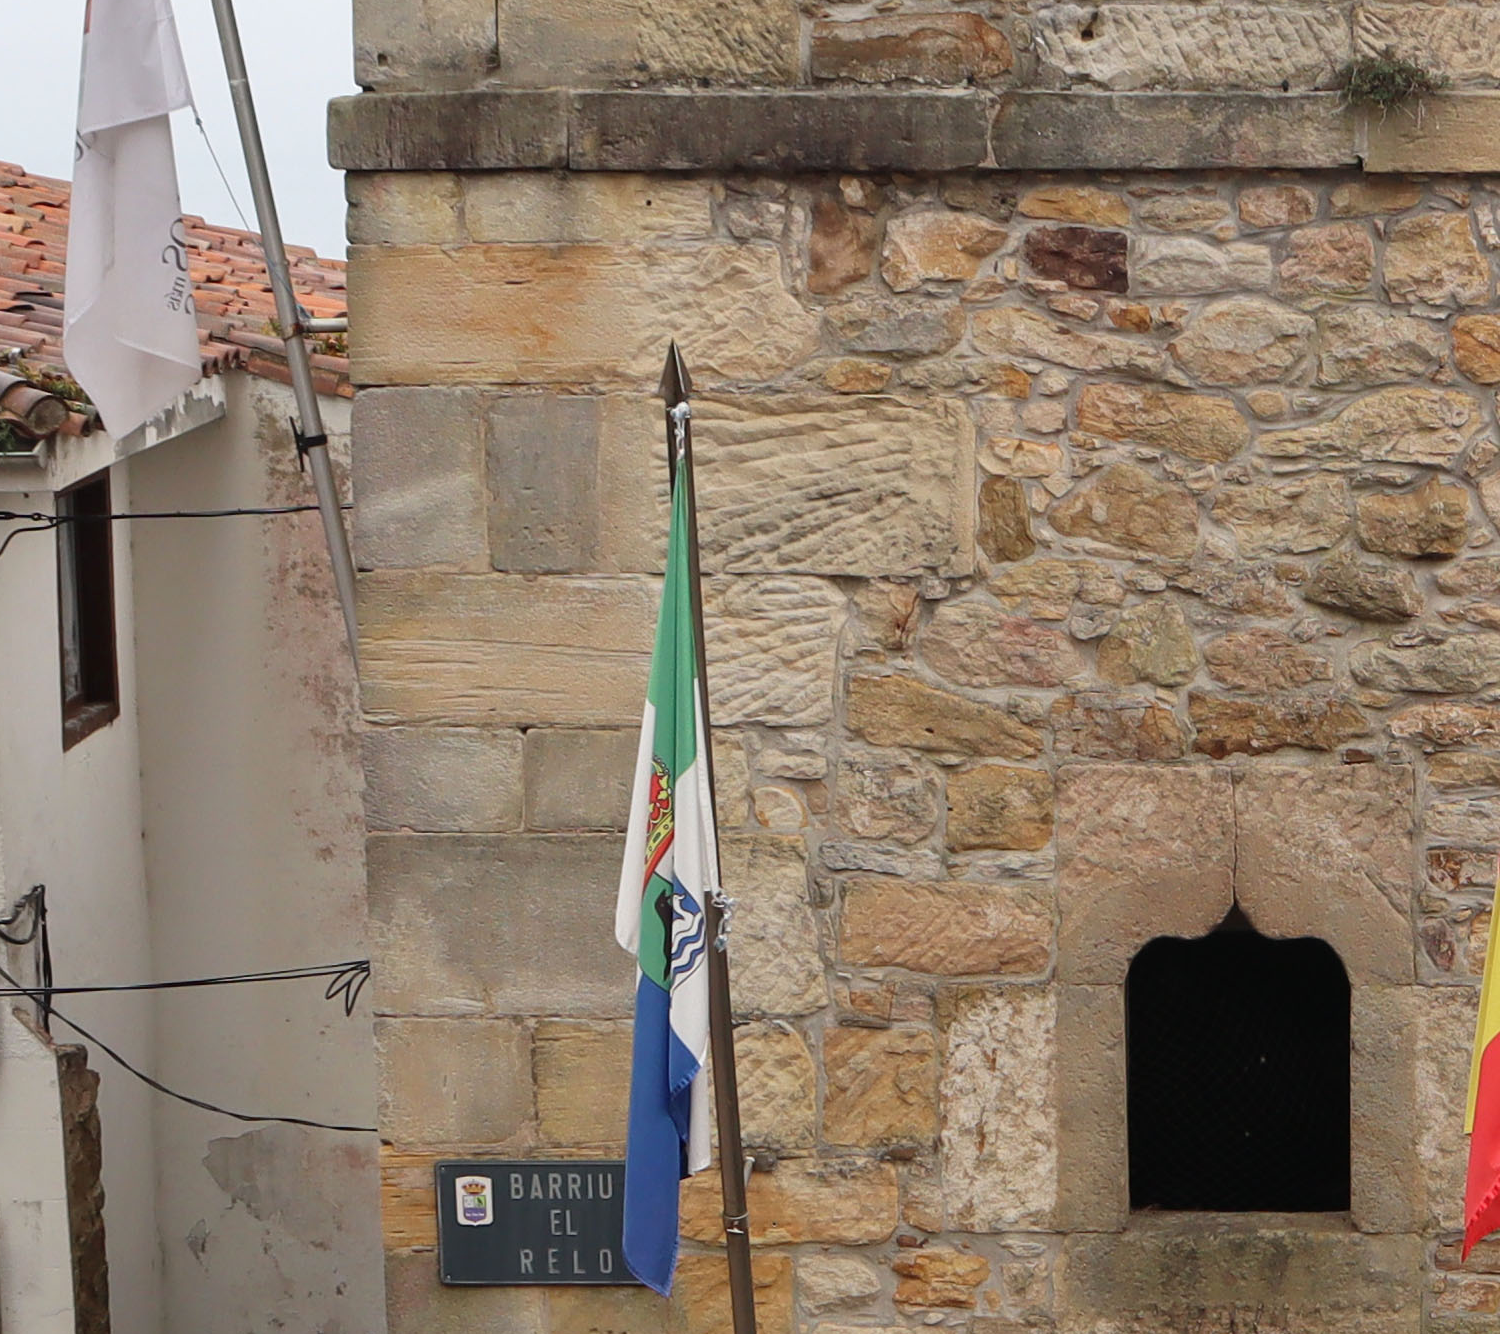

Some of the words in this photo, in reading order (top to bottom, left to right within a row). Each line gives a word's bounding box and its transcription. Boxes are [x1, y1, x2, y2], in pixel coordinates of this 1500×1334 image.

[510, 1173, 614, 1200] BARRIU
[550, 1209, 578, 1237] EL
[520, 1248, 613, 1275] RELO
